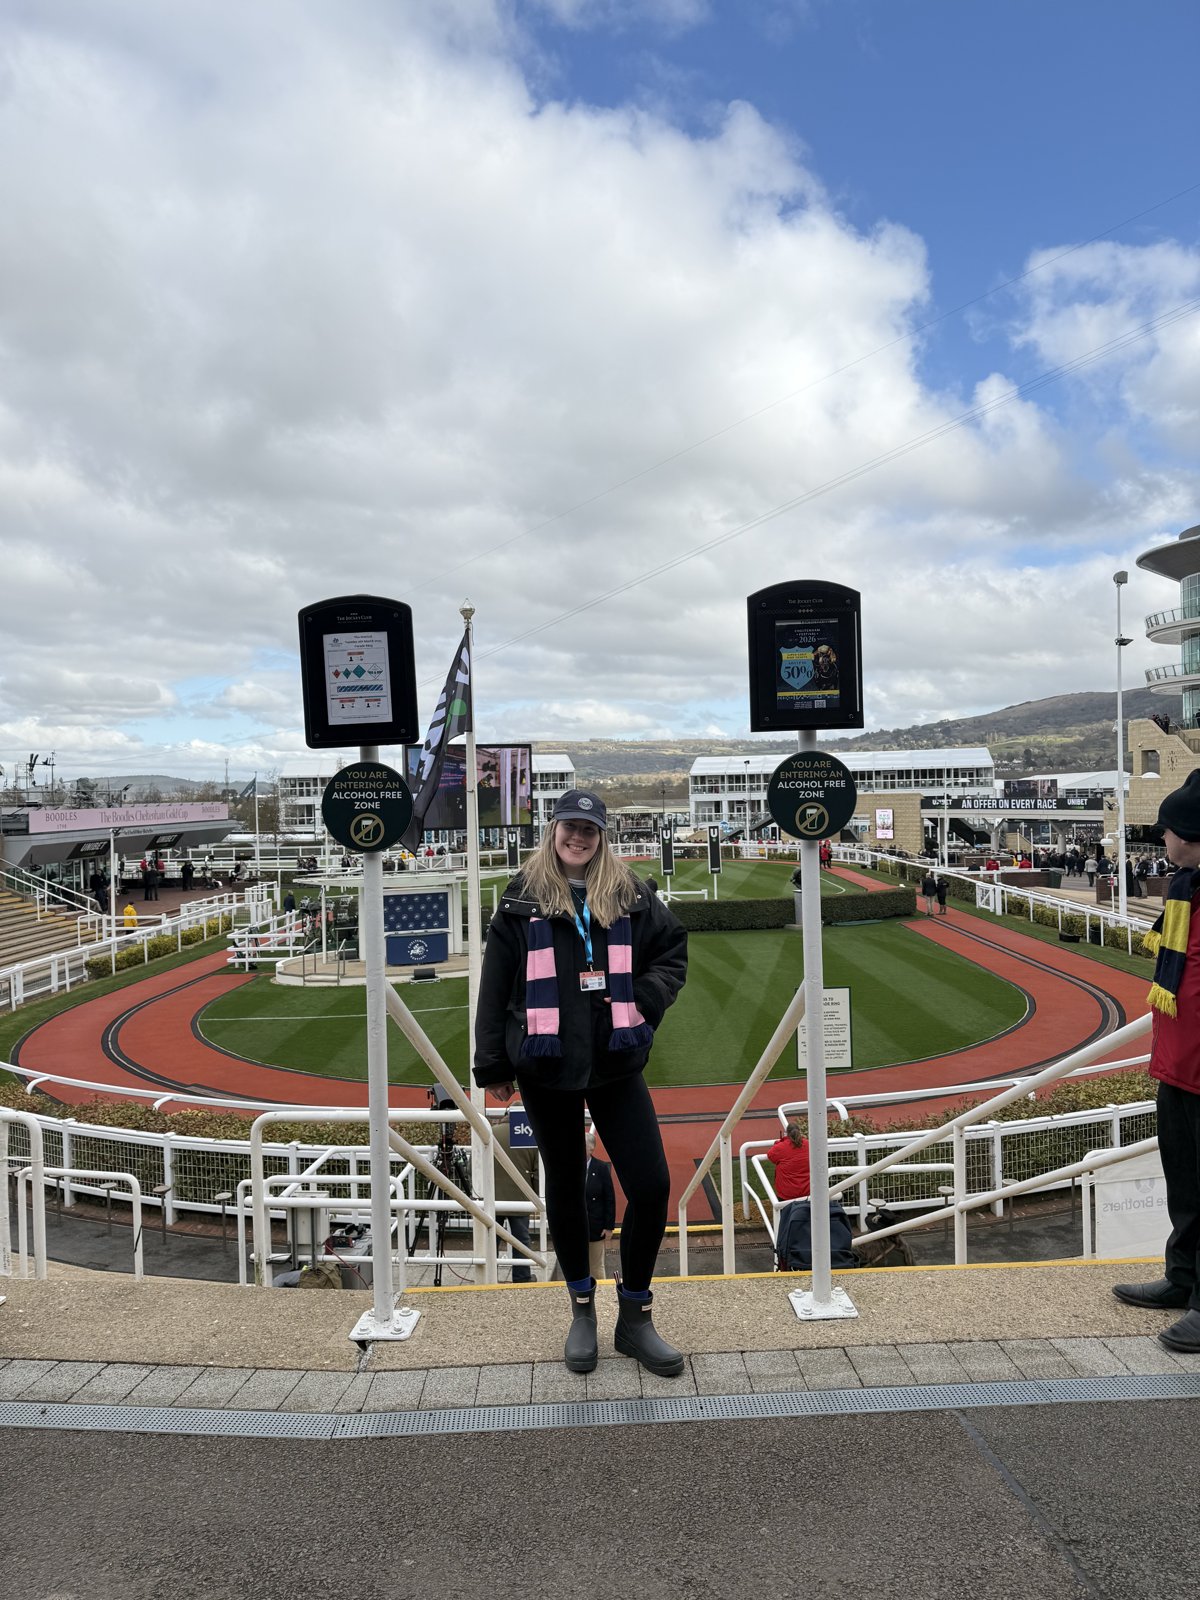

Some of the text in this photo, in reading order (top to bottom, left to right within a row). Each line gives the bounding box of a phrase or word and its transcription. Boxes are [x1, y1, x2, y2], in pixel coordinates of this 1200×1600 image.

[799, 635, 816, 643] 2026
[784, 665, 812, 679] 50%
[791, 760, 832, 769] YOU ARE
[346, 771, 367, 779] YOU
[780, 770, 843, 779] ENTERING AN
[334, 781, 400, 789] ENTERING AN
[777, 780, 846, 789] ALCOHOL FREE
[332, 791, 402, 800] ALCOHOL FREE
[799, 790, 825, 799] ZONE
[354, 801, 380, 810] ZONE
[962, 799, 972, 808] AN
[974, 799, 997, 808] OFFER
[999, 799, 1009, 808] ON
[1011, 799, 1035, 808] EVERY
[1037, 799, 1057, 808] RACE
[46, 808, 188, 823] BOODLES The Boodles Cheltenham Gold Cup
[509, 833, 516, 842] U
[663, 829, 671, 839] U
[710, 828, 718, 838] U
[514, 1123, 533, 1136] sky
